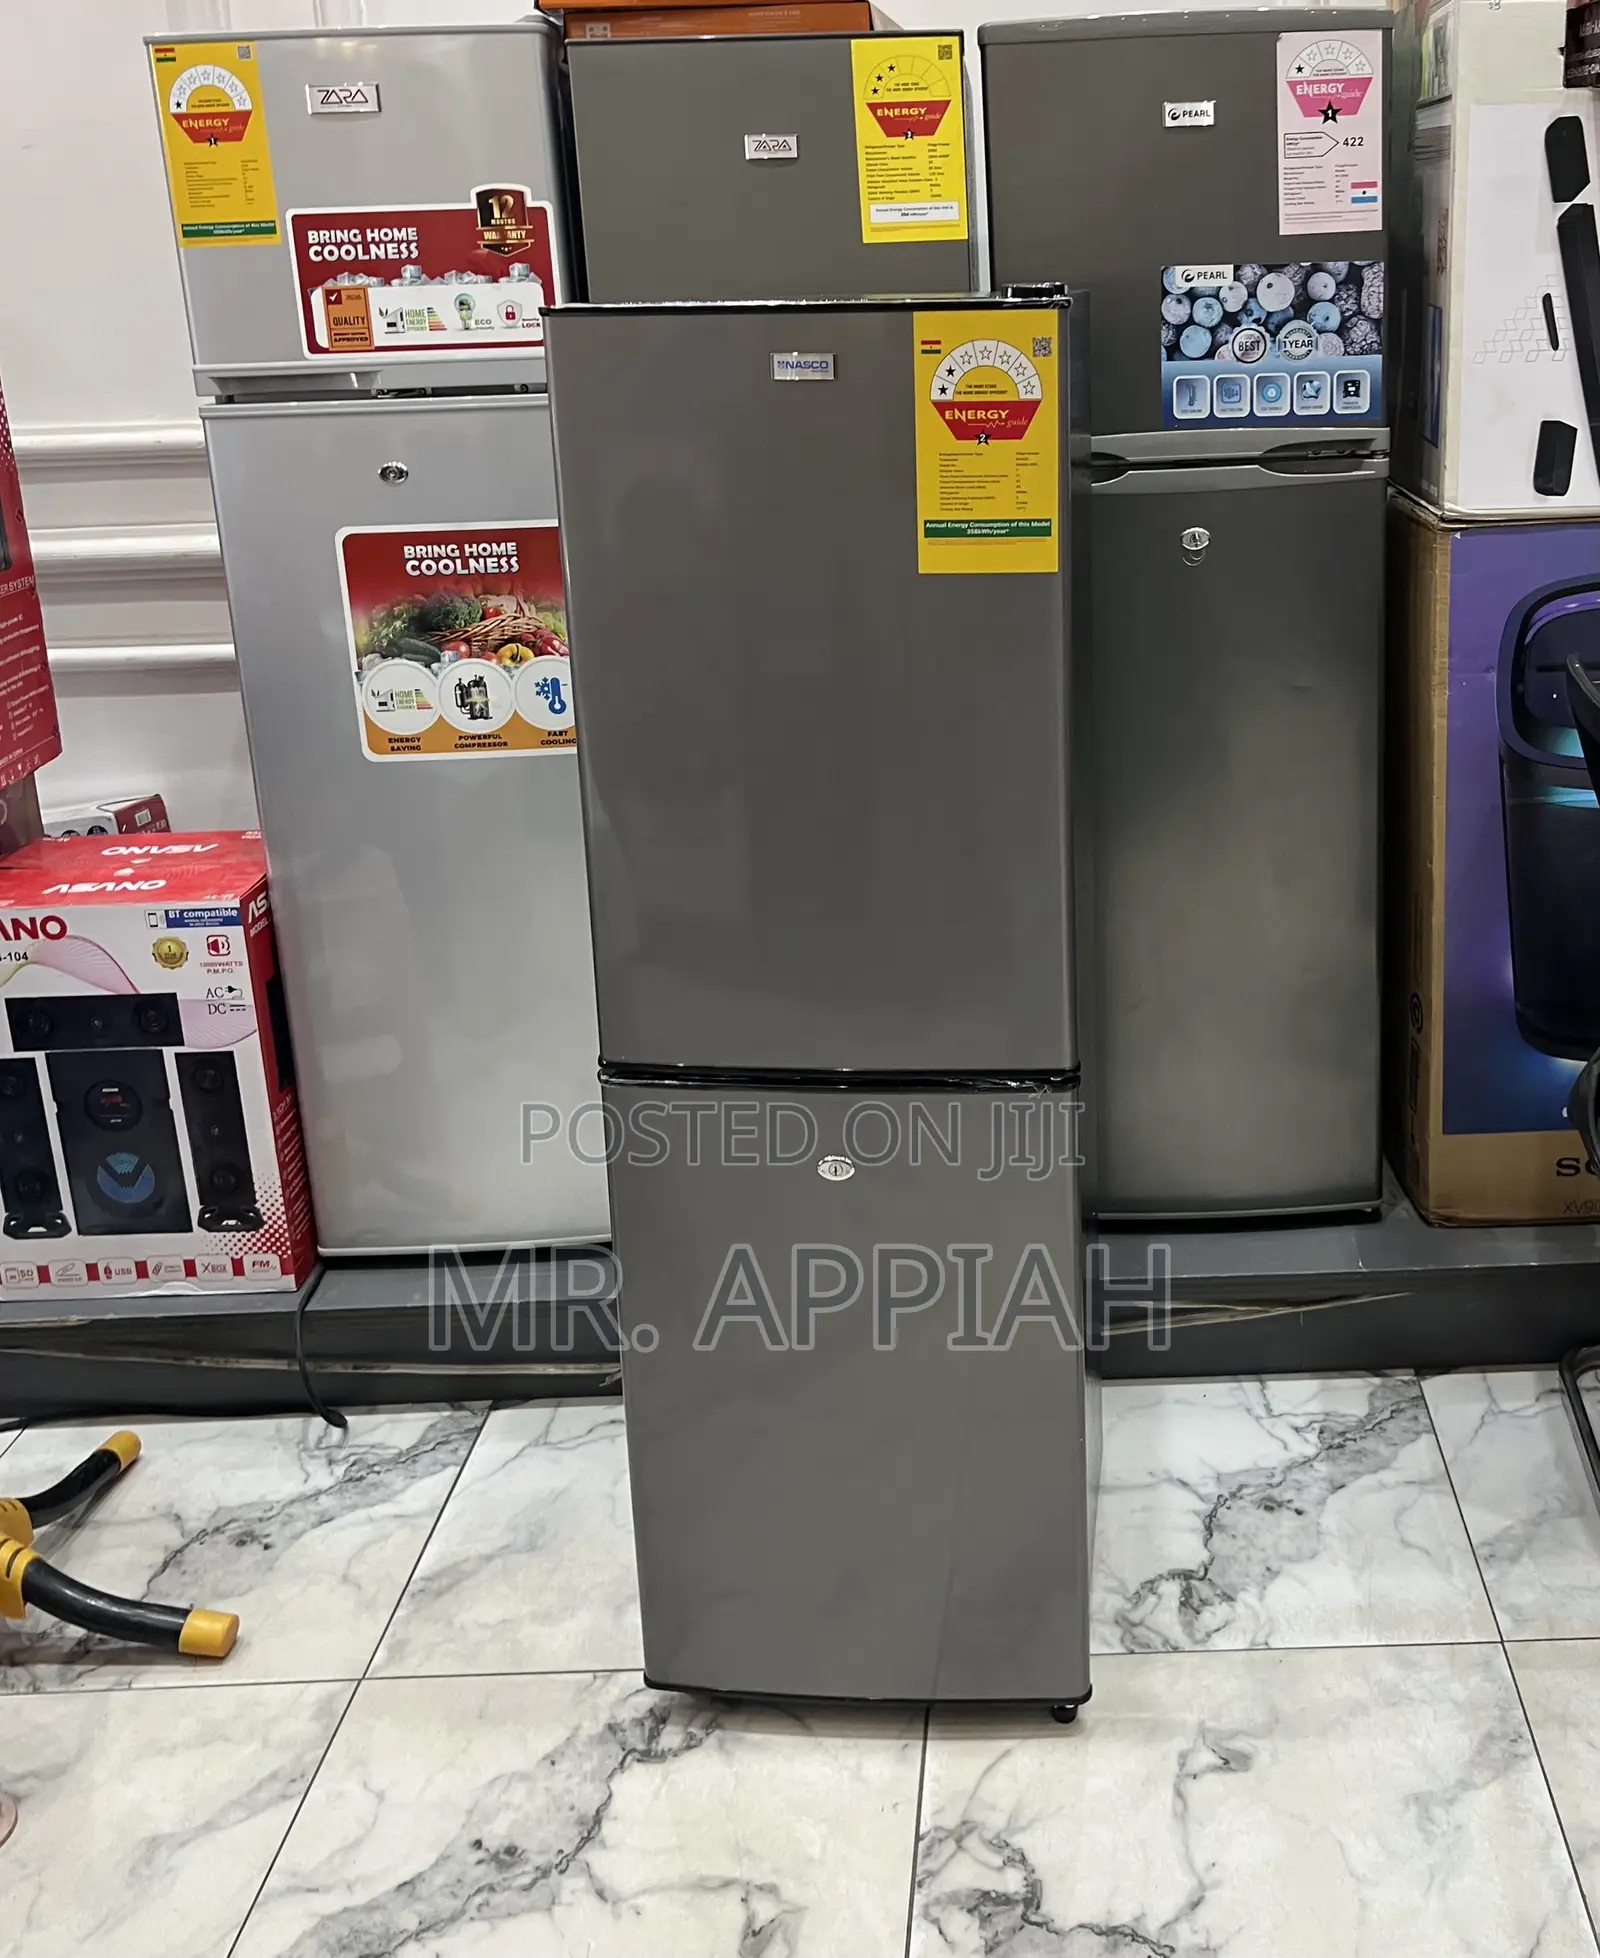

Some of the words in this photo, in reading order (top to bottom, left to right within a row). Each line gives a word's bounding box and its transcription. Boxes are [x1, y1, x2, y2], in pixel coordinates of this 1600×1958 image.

[1296, 81, 1345, 97] ENERGY
[317, 88, 369, 104] ZARA
[876, 106, 928, 118] ENERGY
[1182, 109, 1211, 118] PEARL
[1327, 109, 1332, 117] 1
[182, 118, 230, 130] ENERGY
[752, 139, 792, 152] ZARA
[1342, 136, 1364, 147] 422
[489, 195, 515, 218] 12
[307, 229, 362, 244] BRING
[366, 228, 418, 242] HOME
[483, 230, 526, 240] WAANTY
[308, 243, 419, 262] COOLNESS
[1197, 271, 1227, 280] PEARL
[405, 309, 426, 318] HOME
[332, 316, 365, 326] QUALITY
[1239, 340, 1260, 352] BEST
[1288, 340, 1313, 349] YEAR
[785, 361, 829, 369] NASCO
[944, 408, 1009, 423] ENERGY
[1006, 416, 1028, 428] guide
[979, 433, 986, 441] 2
[403, 544, 459, 560] BRING
[464, 542, 518, 556] HOME
[405, 556, 520, 577] COOLNESS
[395, 690, 414, 699] HOME
[458, 733, 502, 741] POWERFUL
[547, 730, 569, 738] FAST
[454, 741, 509, 749] COMPRESSOR
[42, 879, 167, 895] ASANO
[168, 909, 180, 919] BT
[183, 907, 238, 920] compatible
[206, 987, 224, 999] AC
[208, 1003, 226, 1015] DC
[252, 1260, 270, 1268] FM
[20, 1269, 34, 1278] SD
[114, 1267, 132, 1276] USB
